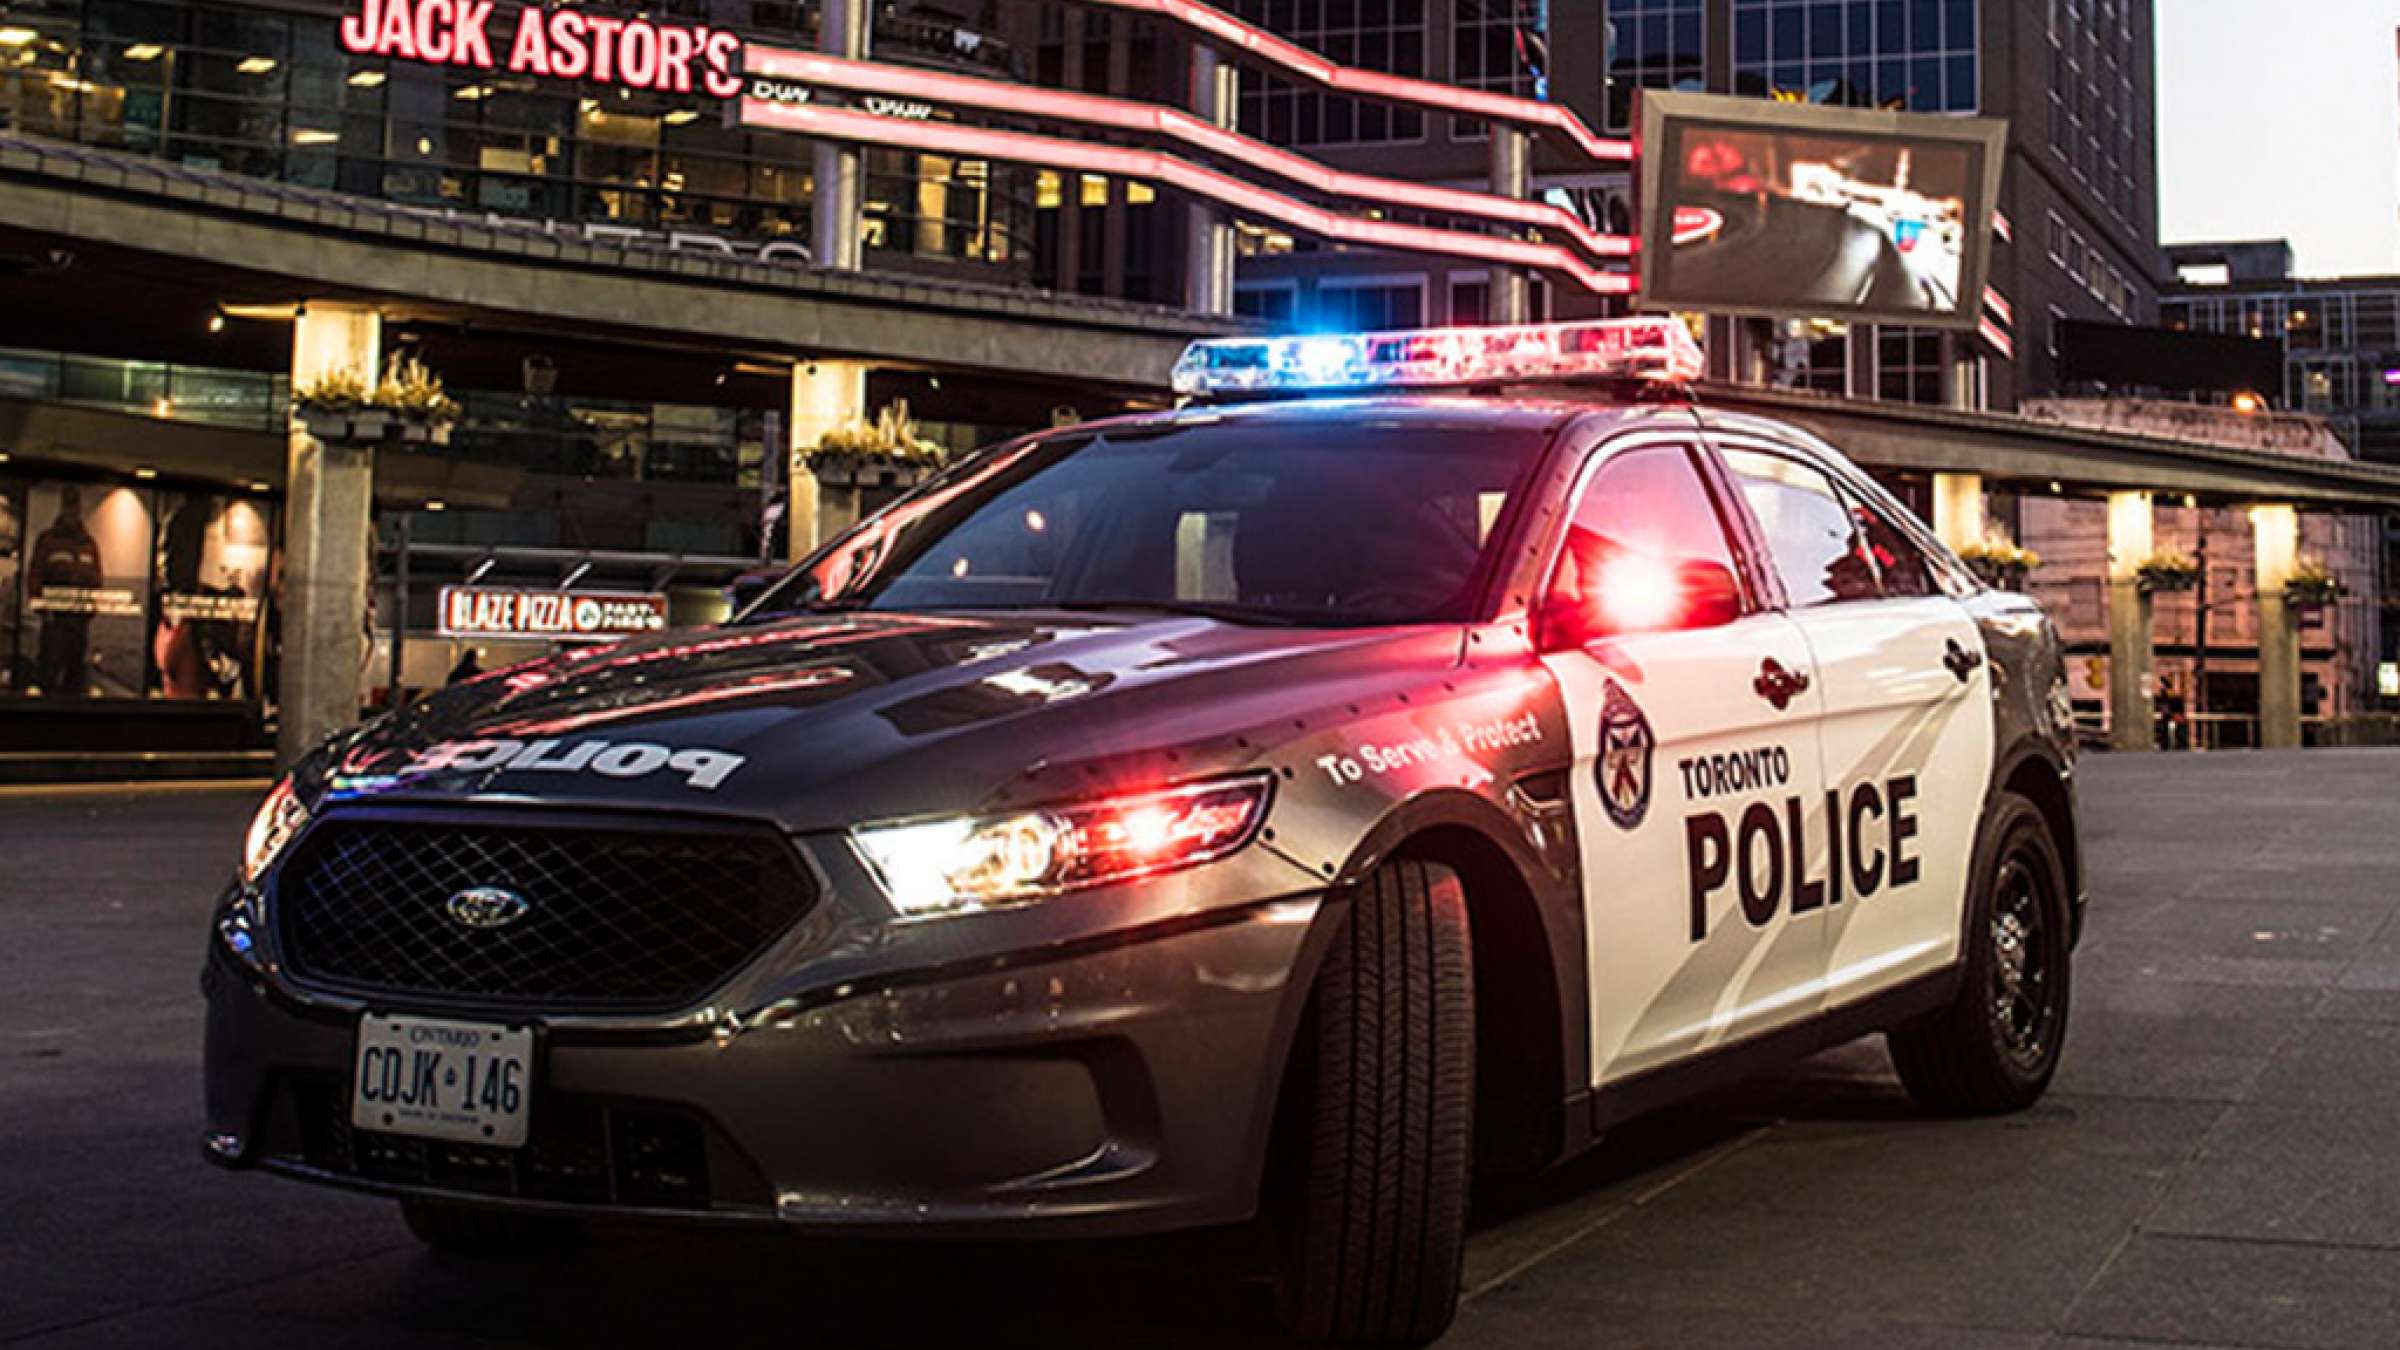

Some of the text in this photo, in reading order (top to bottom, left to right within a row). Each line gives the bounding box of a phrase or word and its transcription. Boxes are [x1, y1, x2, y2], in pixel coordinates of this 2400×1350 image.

[341, 0, 744, 98] JACK ASTOR'S
[452, 591, 572, 631] BLAZE PIZZA
[1316, 754, 1363, 785] To
[1359, 738, 1439, 773] Serve
[1458, 712, 1543, 753] Protect
[1678, 745, 1791, 800] TORONTO
[1686, 775, 1920, 944] POLICE
[362, 1047, 522, 1115] CDJK 146
